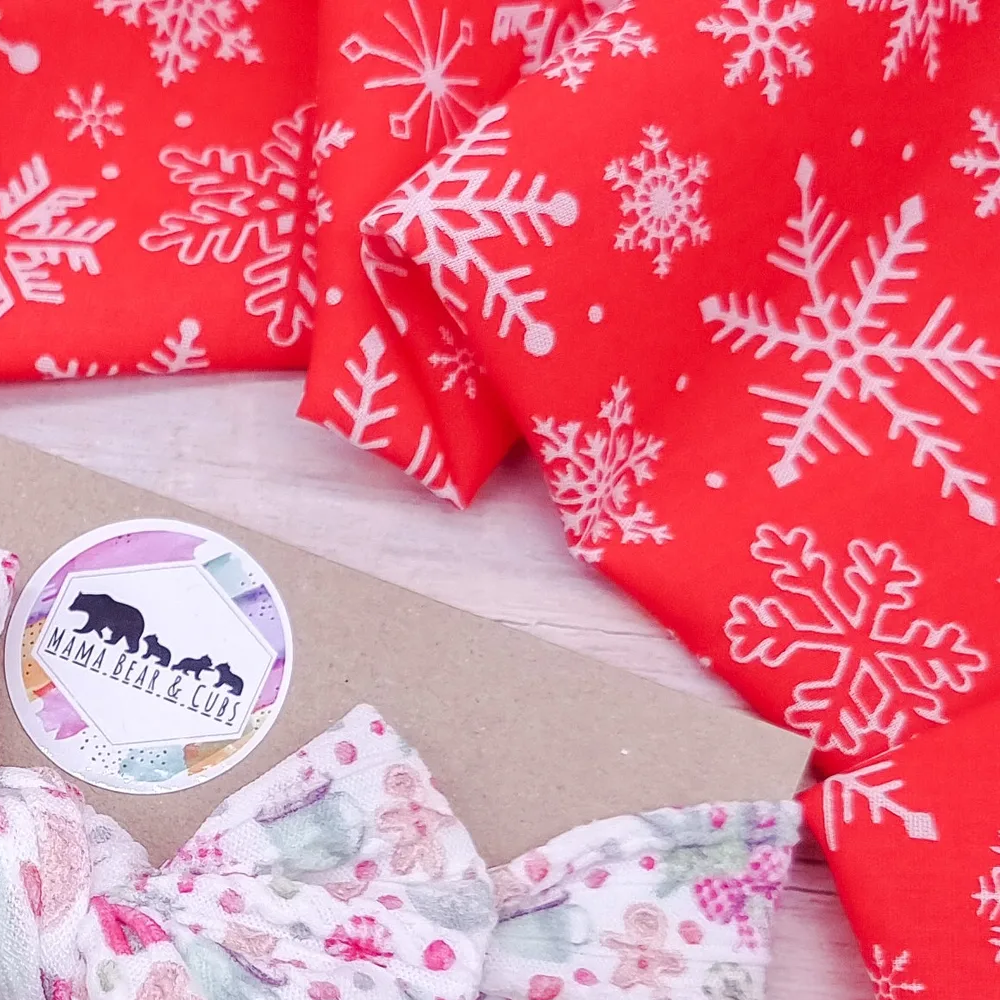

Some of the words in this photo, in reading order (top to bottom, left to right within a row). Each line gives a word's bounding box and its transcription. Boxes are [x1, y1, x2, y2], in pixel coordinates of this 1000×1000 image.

[46, 626, 108, 669] MAMA
[112, 653, 161, 691] BEAR
[167, 674, 182, 700] &
[190, 684, 241, 722] CUBS
